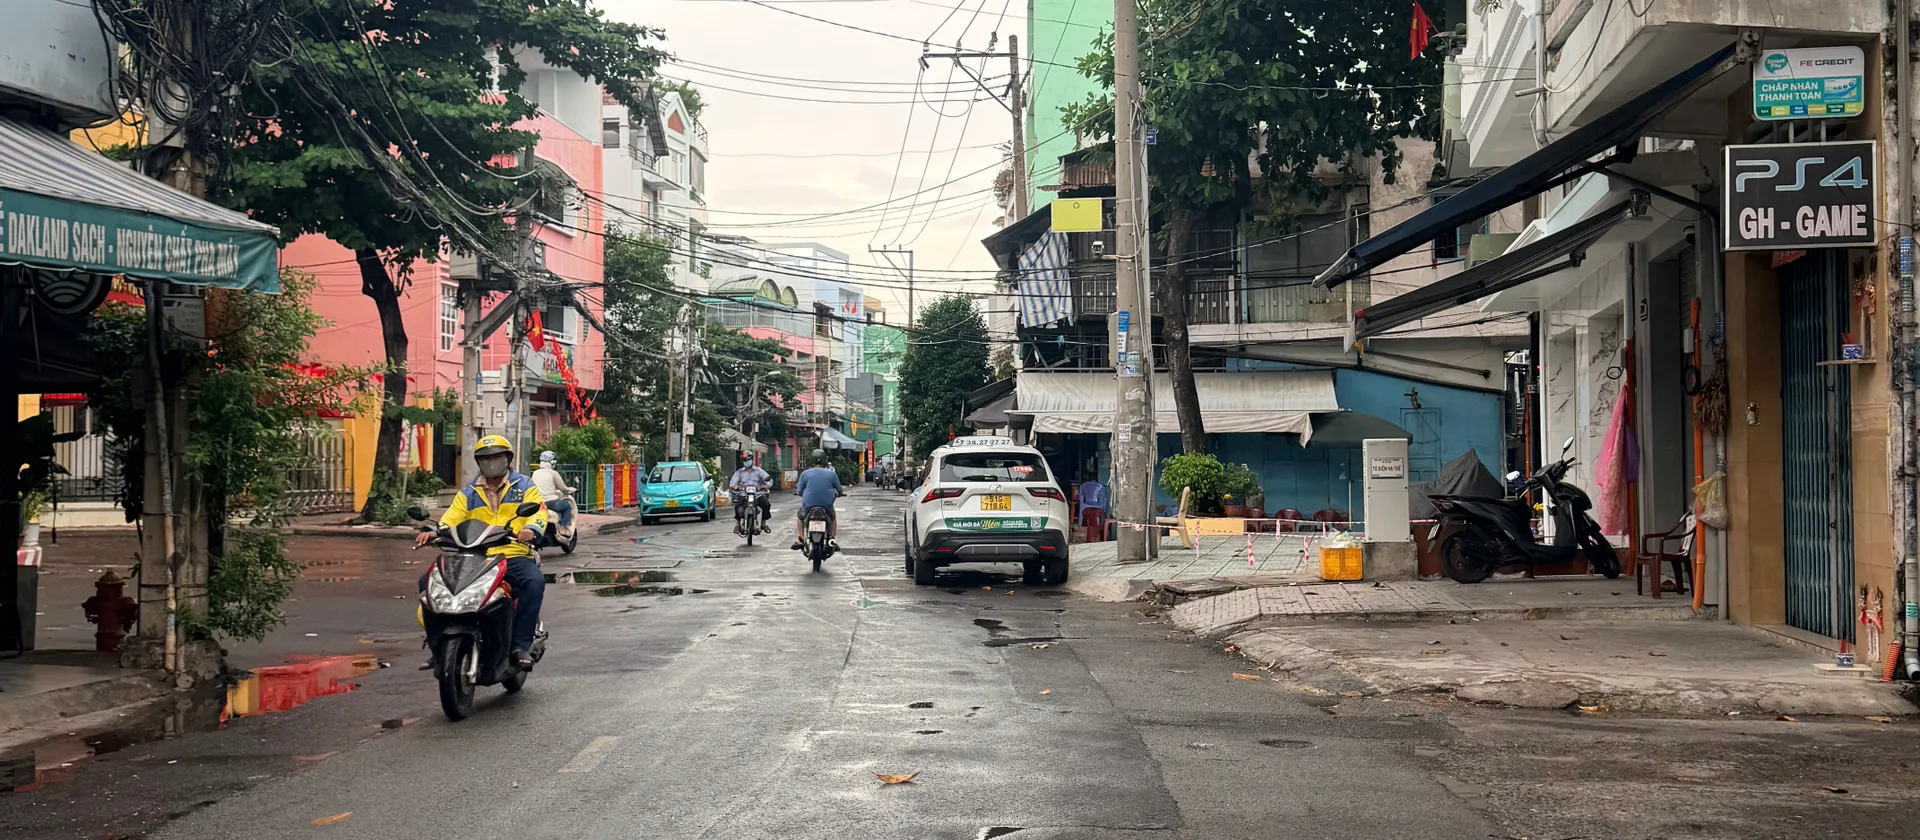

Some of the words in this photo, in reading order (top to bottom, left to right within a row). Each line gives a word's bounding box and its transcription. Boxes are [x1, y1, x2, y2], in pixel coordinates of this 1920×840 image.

[1814, 58, 1855, 66] CREDIT
[1759, 92, 1793, 102] THANH
[1761, 80, 1789, 92] CHẤP
[1735, 155, 1869, 193] PS4
[1739, 206, 1775, 240] GH
[1795, 204, 1868, 239] GAME
[8, 211, 69, 260] DAKLAND
[116, 224, 163, 271] NGUYÊN
[165, 224, 193, 274] CHẤT
[194, 240, 216, 277] PHA
[216, 236, 241, 279] MÁY
